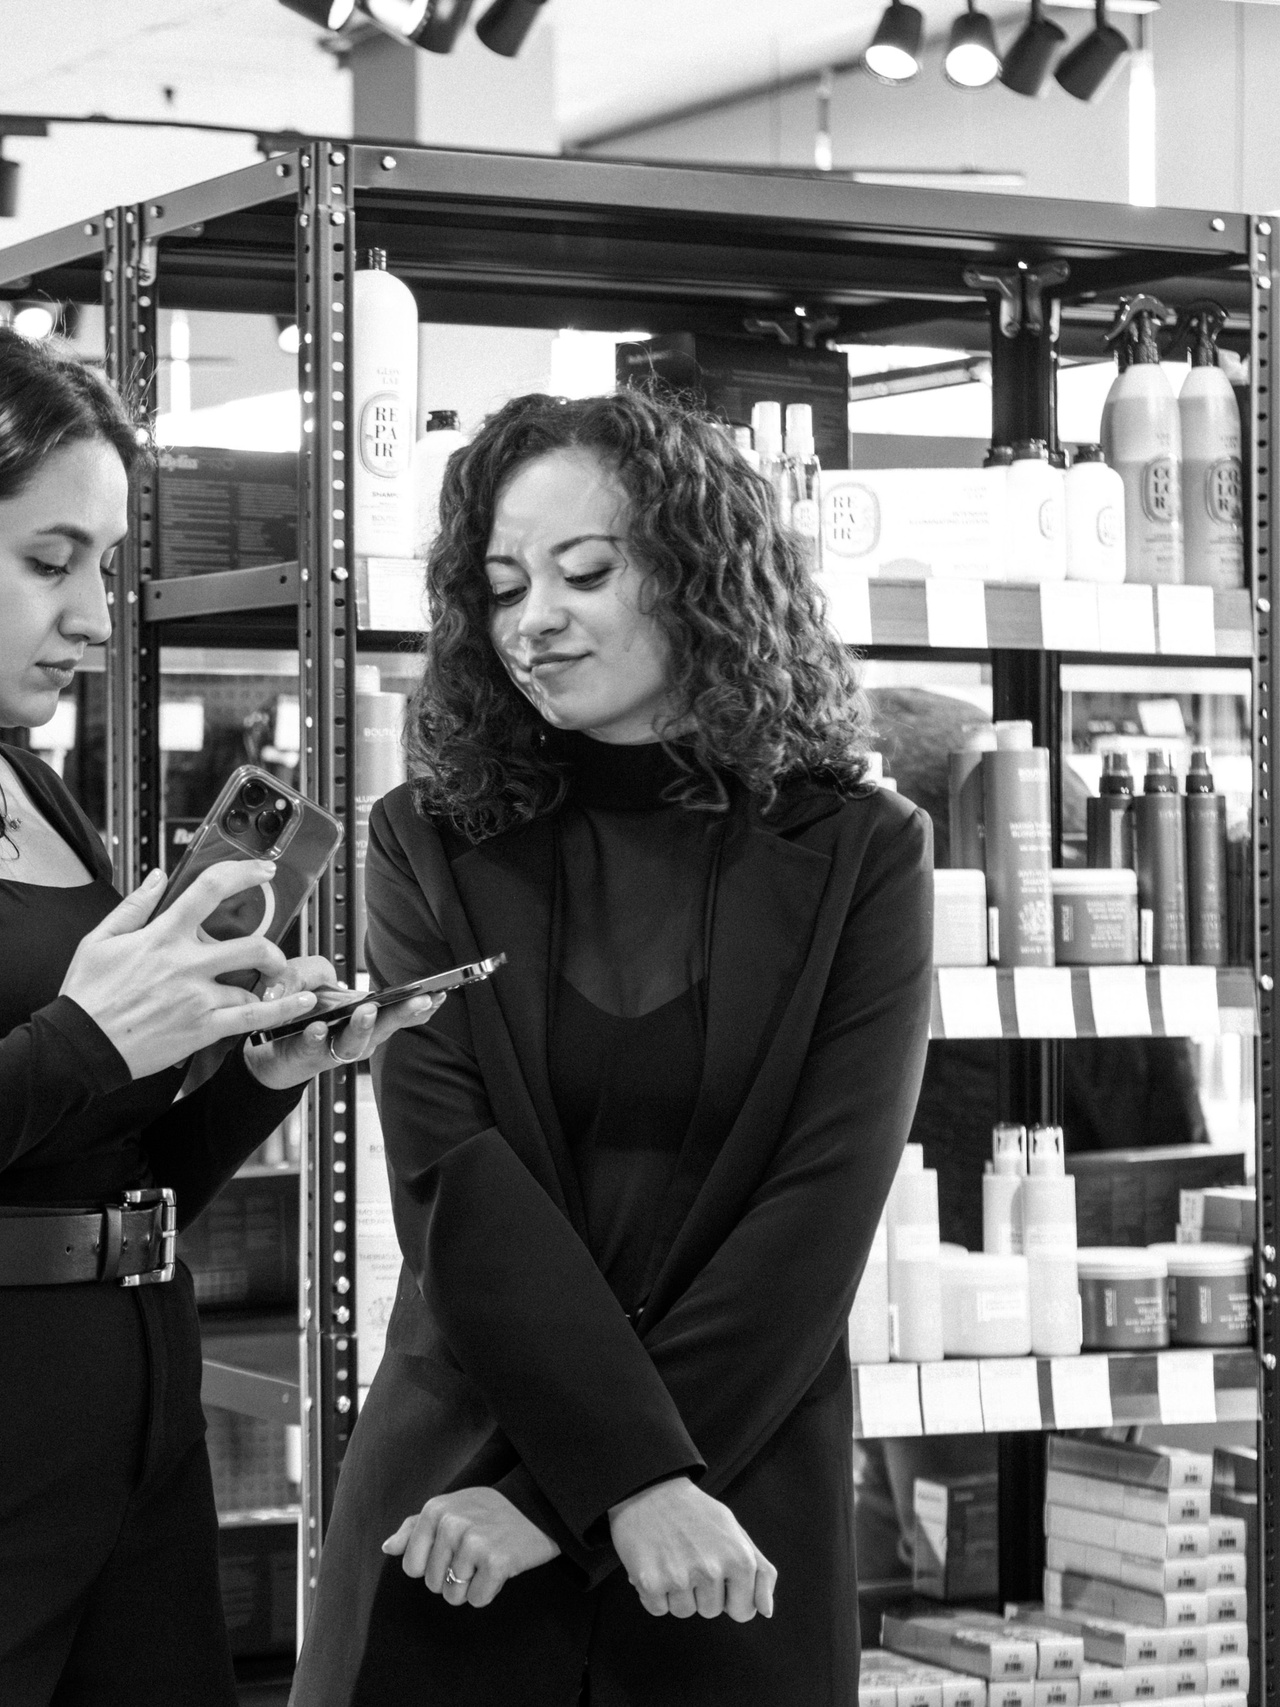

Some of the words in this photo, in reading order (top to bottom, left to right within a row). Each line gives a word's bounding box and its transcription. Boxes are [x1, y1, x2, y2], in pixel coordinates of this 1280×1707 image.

[375, 407, 399, 422] RE
[375, 425, 398, 440] PA
[375, 443, 394, 457] IR
[833, 496, 856, 508] RE
[833, 512, 856, 524] PA
[833, 528, 852, 540] IR
